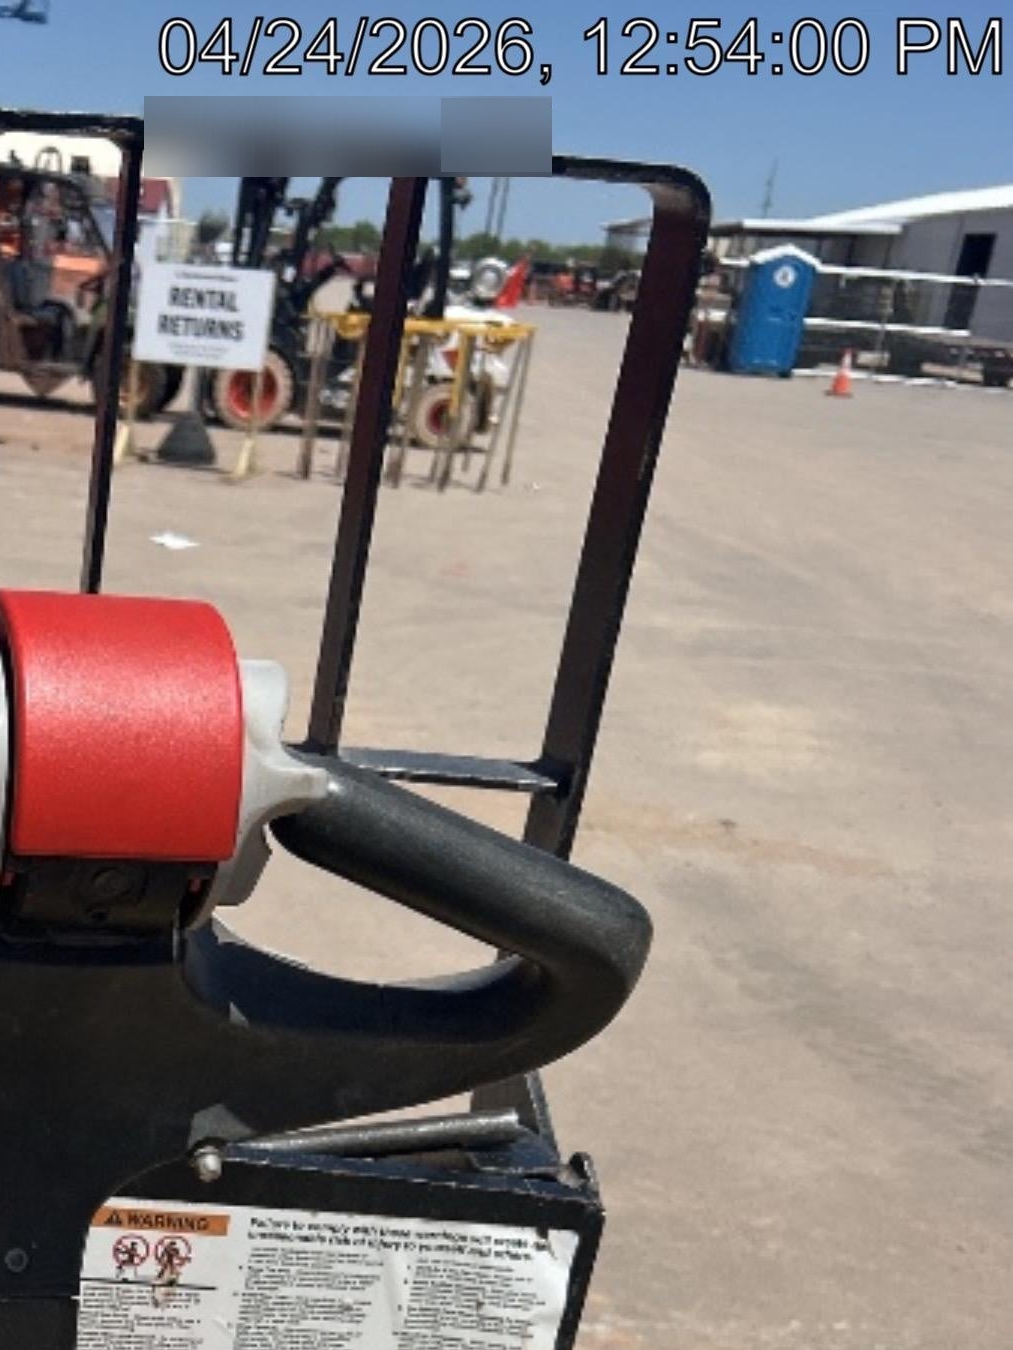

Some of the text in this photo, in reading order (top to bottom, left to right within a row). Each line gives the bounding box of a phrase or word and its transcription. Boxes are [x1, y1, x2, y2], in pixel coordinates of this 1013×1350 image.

[169, 286, 239, 312] RENTAL
[157, 313, 245, 342] RETURNS
[127, 1213, 210, 1232] WARNING
